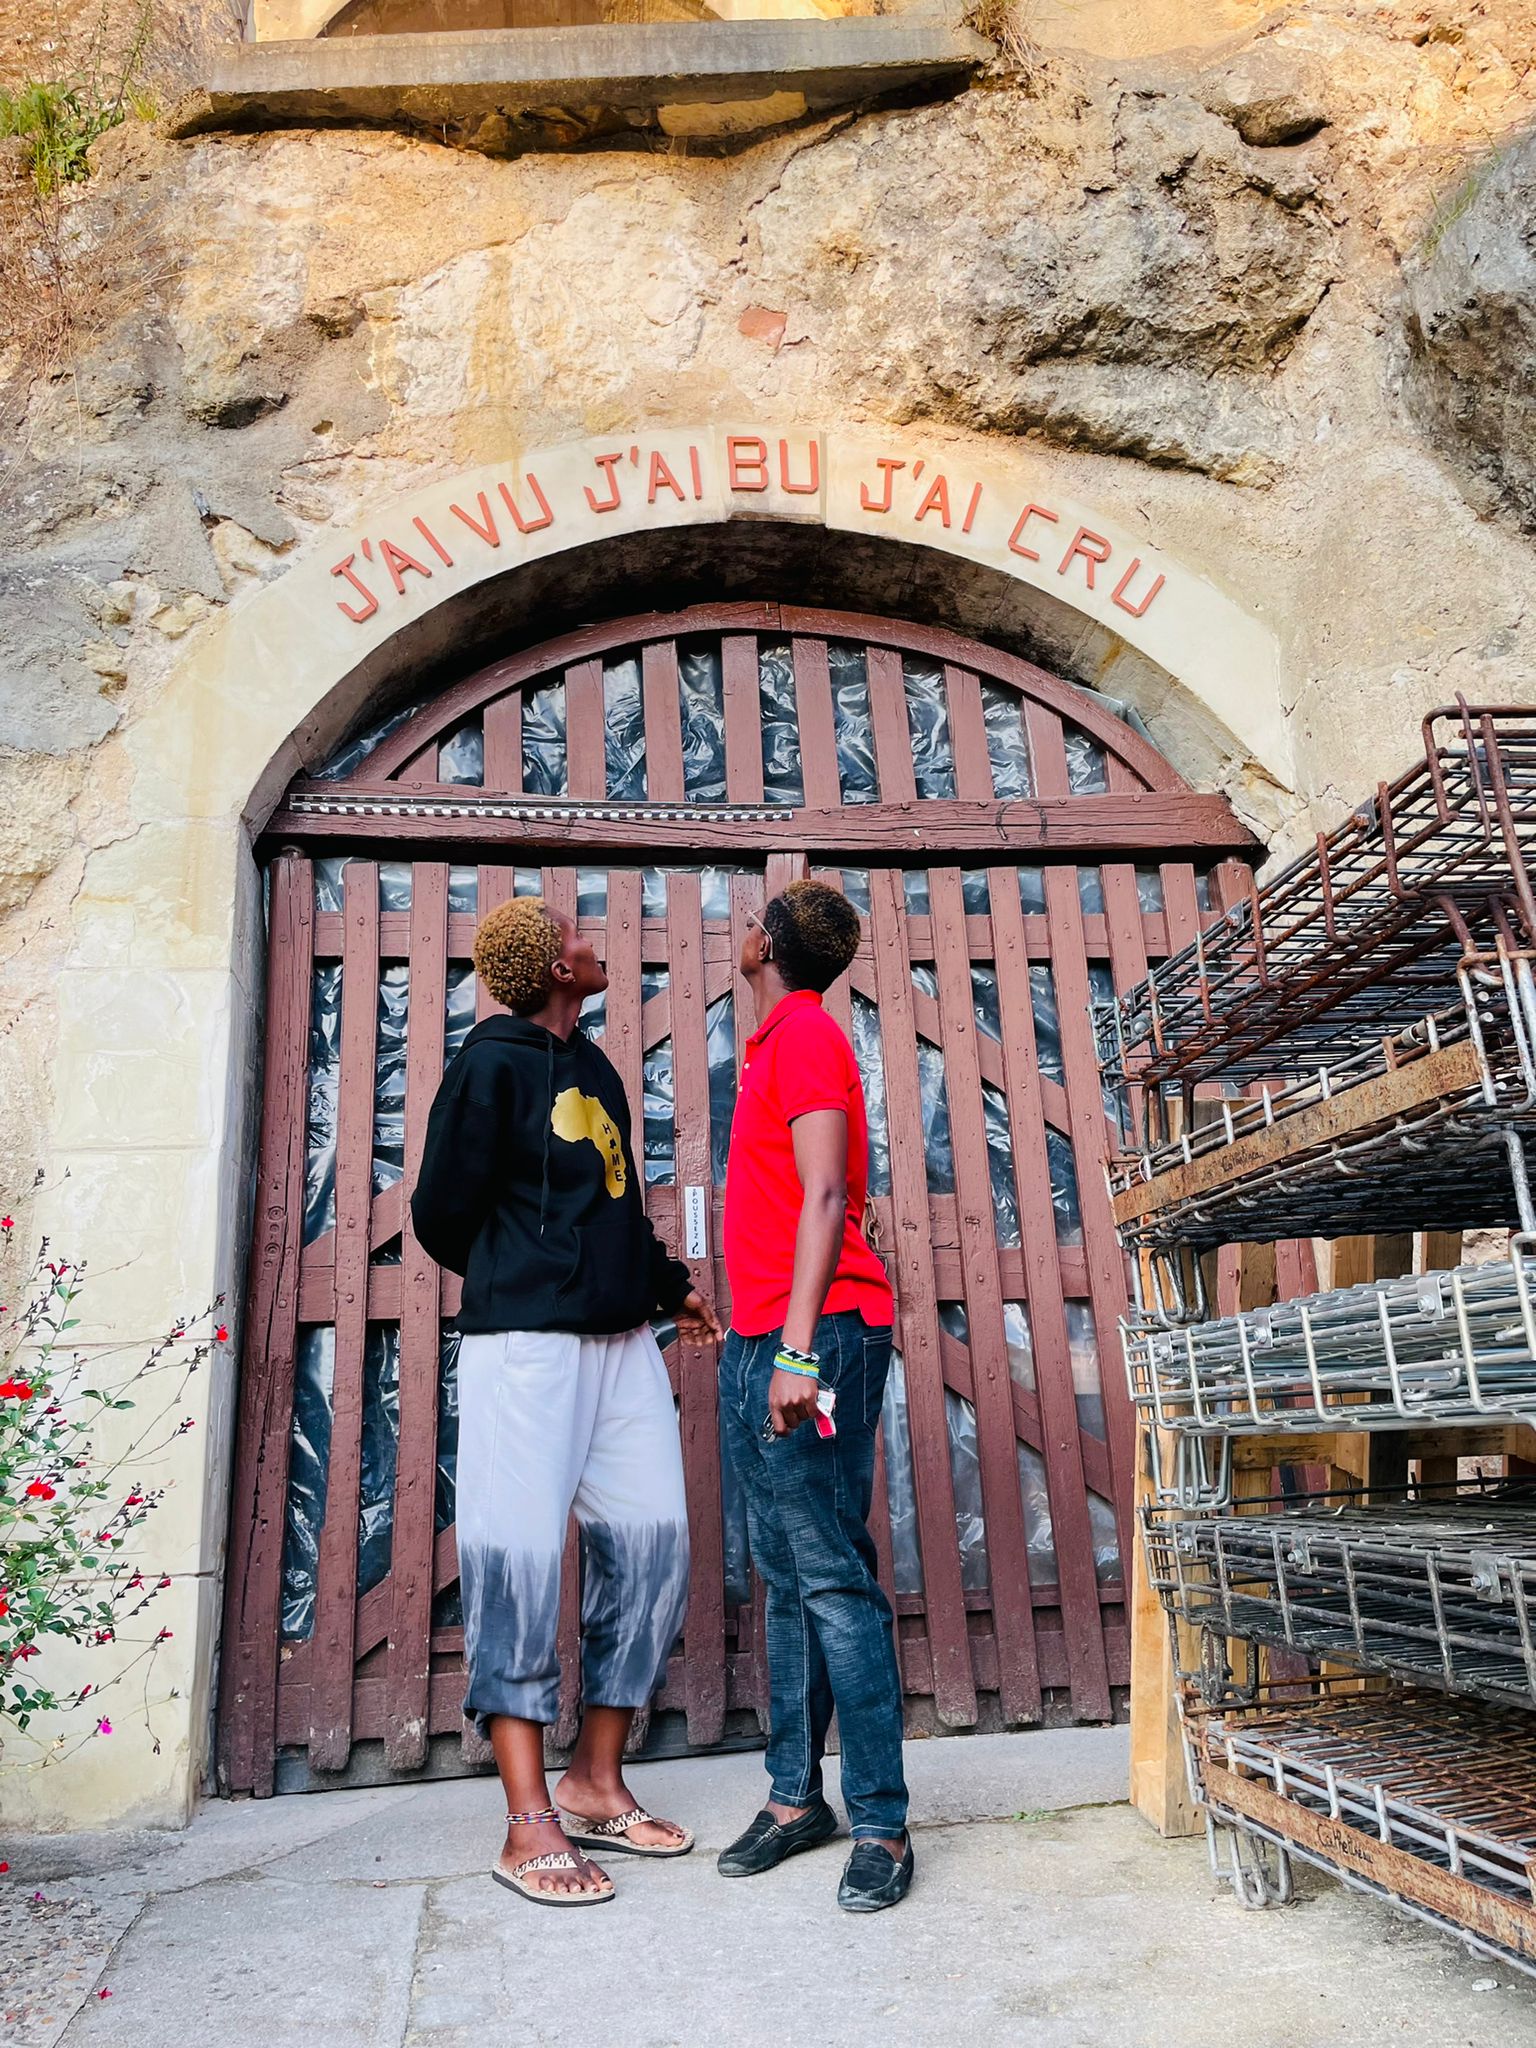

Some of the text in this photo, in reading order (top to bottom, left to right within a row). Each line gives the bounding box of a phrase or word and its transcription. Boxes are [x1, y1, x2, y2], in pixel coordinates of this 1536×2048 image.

[329, 435, 1167, 623] J'AI VU J'AI BU J'AI CRU
